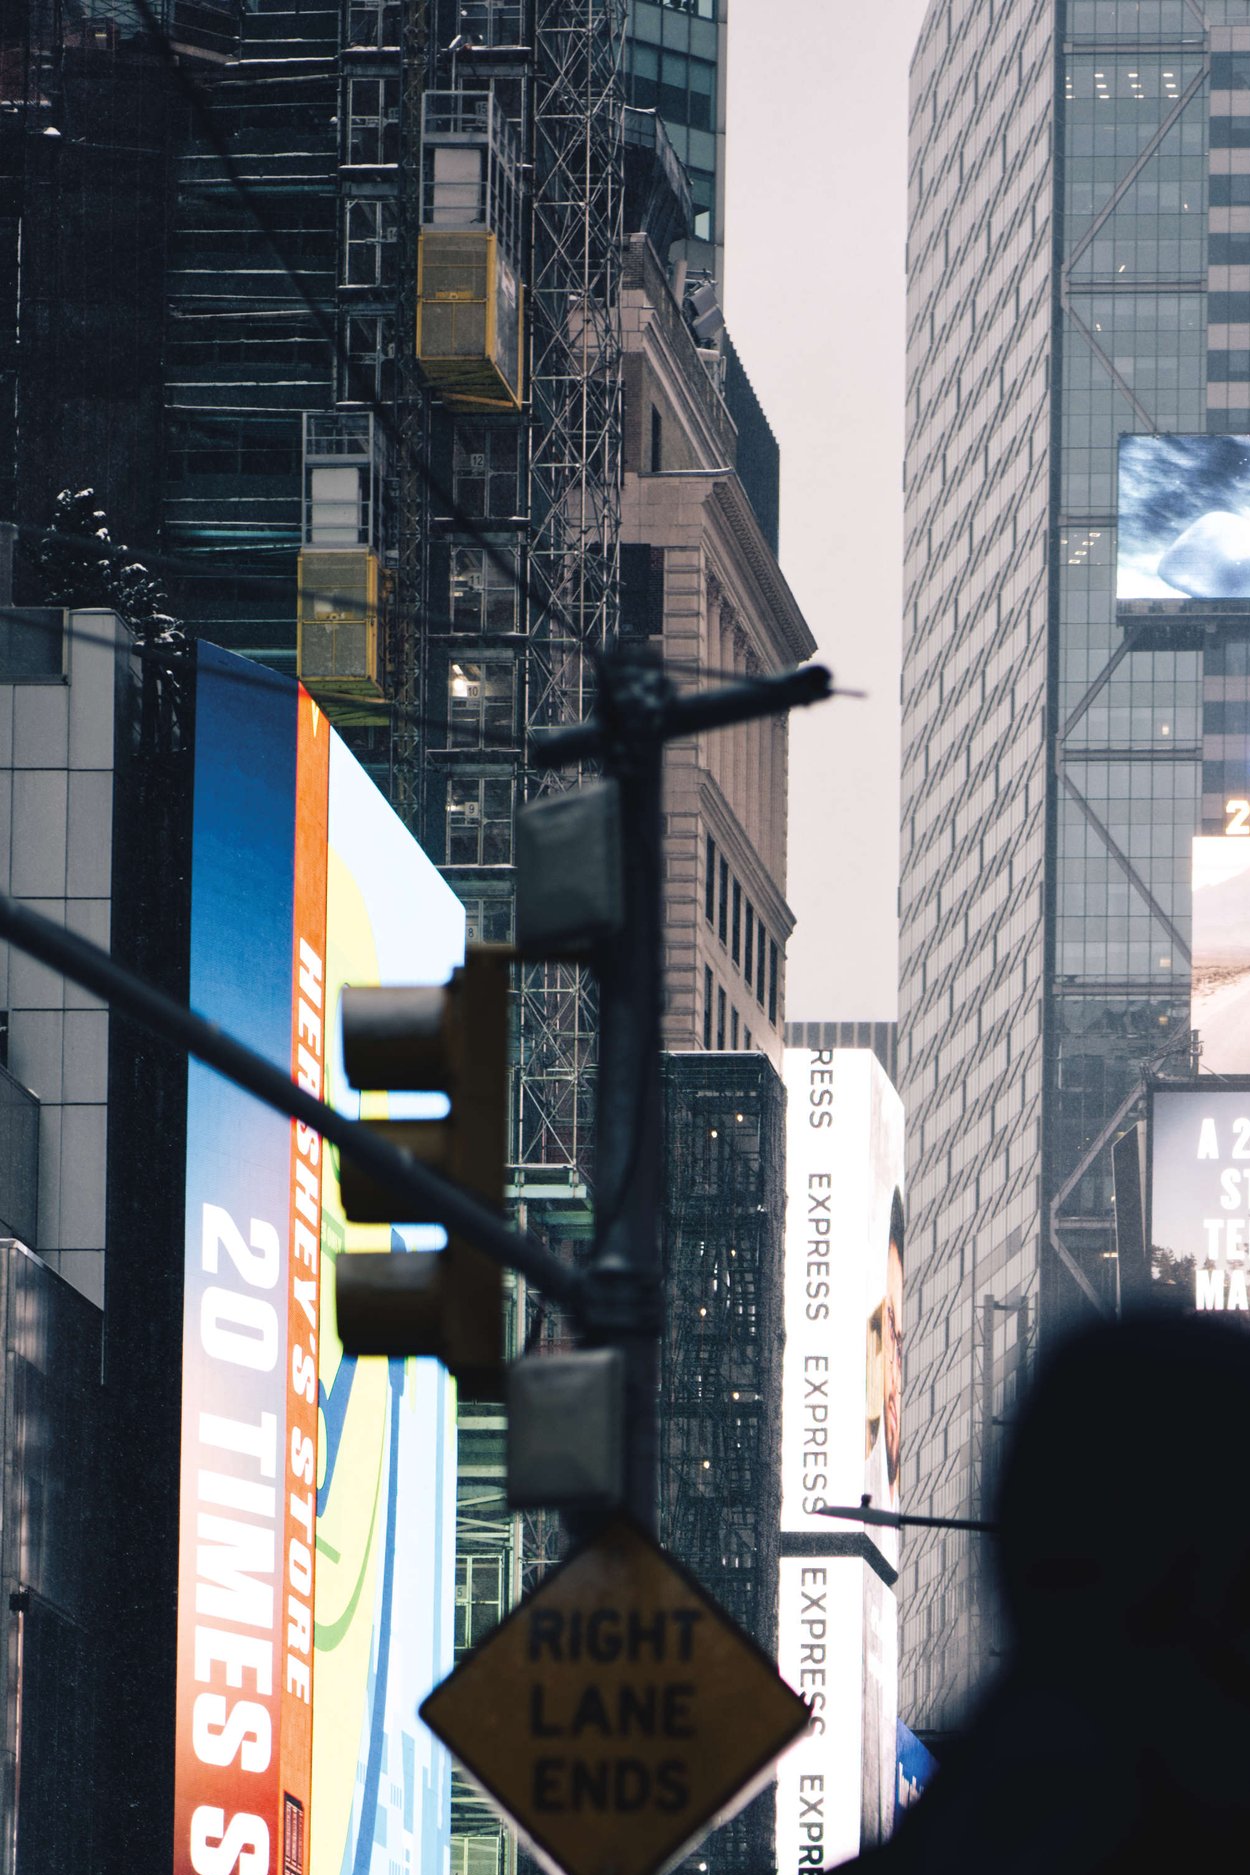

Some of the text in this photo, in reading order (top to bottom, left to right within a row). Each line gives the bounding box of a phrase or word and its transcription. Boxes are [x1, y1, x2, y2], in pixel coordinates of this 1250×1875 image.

[472, 455, 484, 466] 12
[470, 575, 481, 585] 11
[468, 686, 479, 697] 10
[468, 804, 475, 814] 9
[467, 927, 474, 938] 8
[1197, 1117, 1220, 1160] A
[805, 1172, 832, 1321] EXPRESS
[201, 1202, 281, 1374] 20
[802, 1355, 830, 1515] EXPRESS
[192, 1410, 280, 1775] TIMES
[286, 1426, 314, 1706] STORE
[457, 1587, 463, 1597] 5
[528, 1607, 702, 1665] RIGHT
[531, 1682, 697, 1739] LANE
[533, 1756, 690, 1815] ENDS
